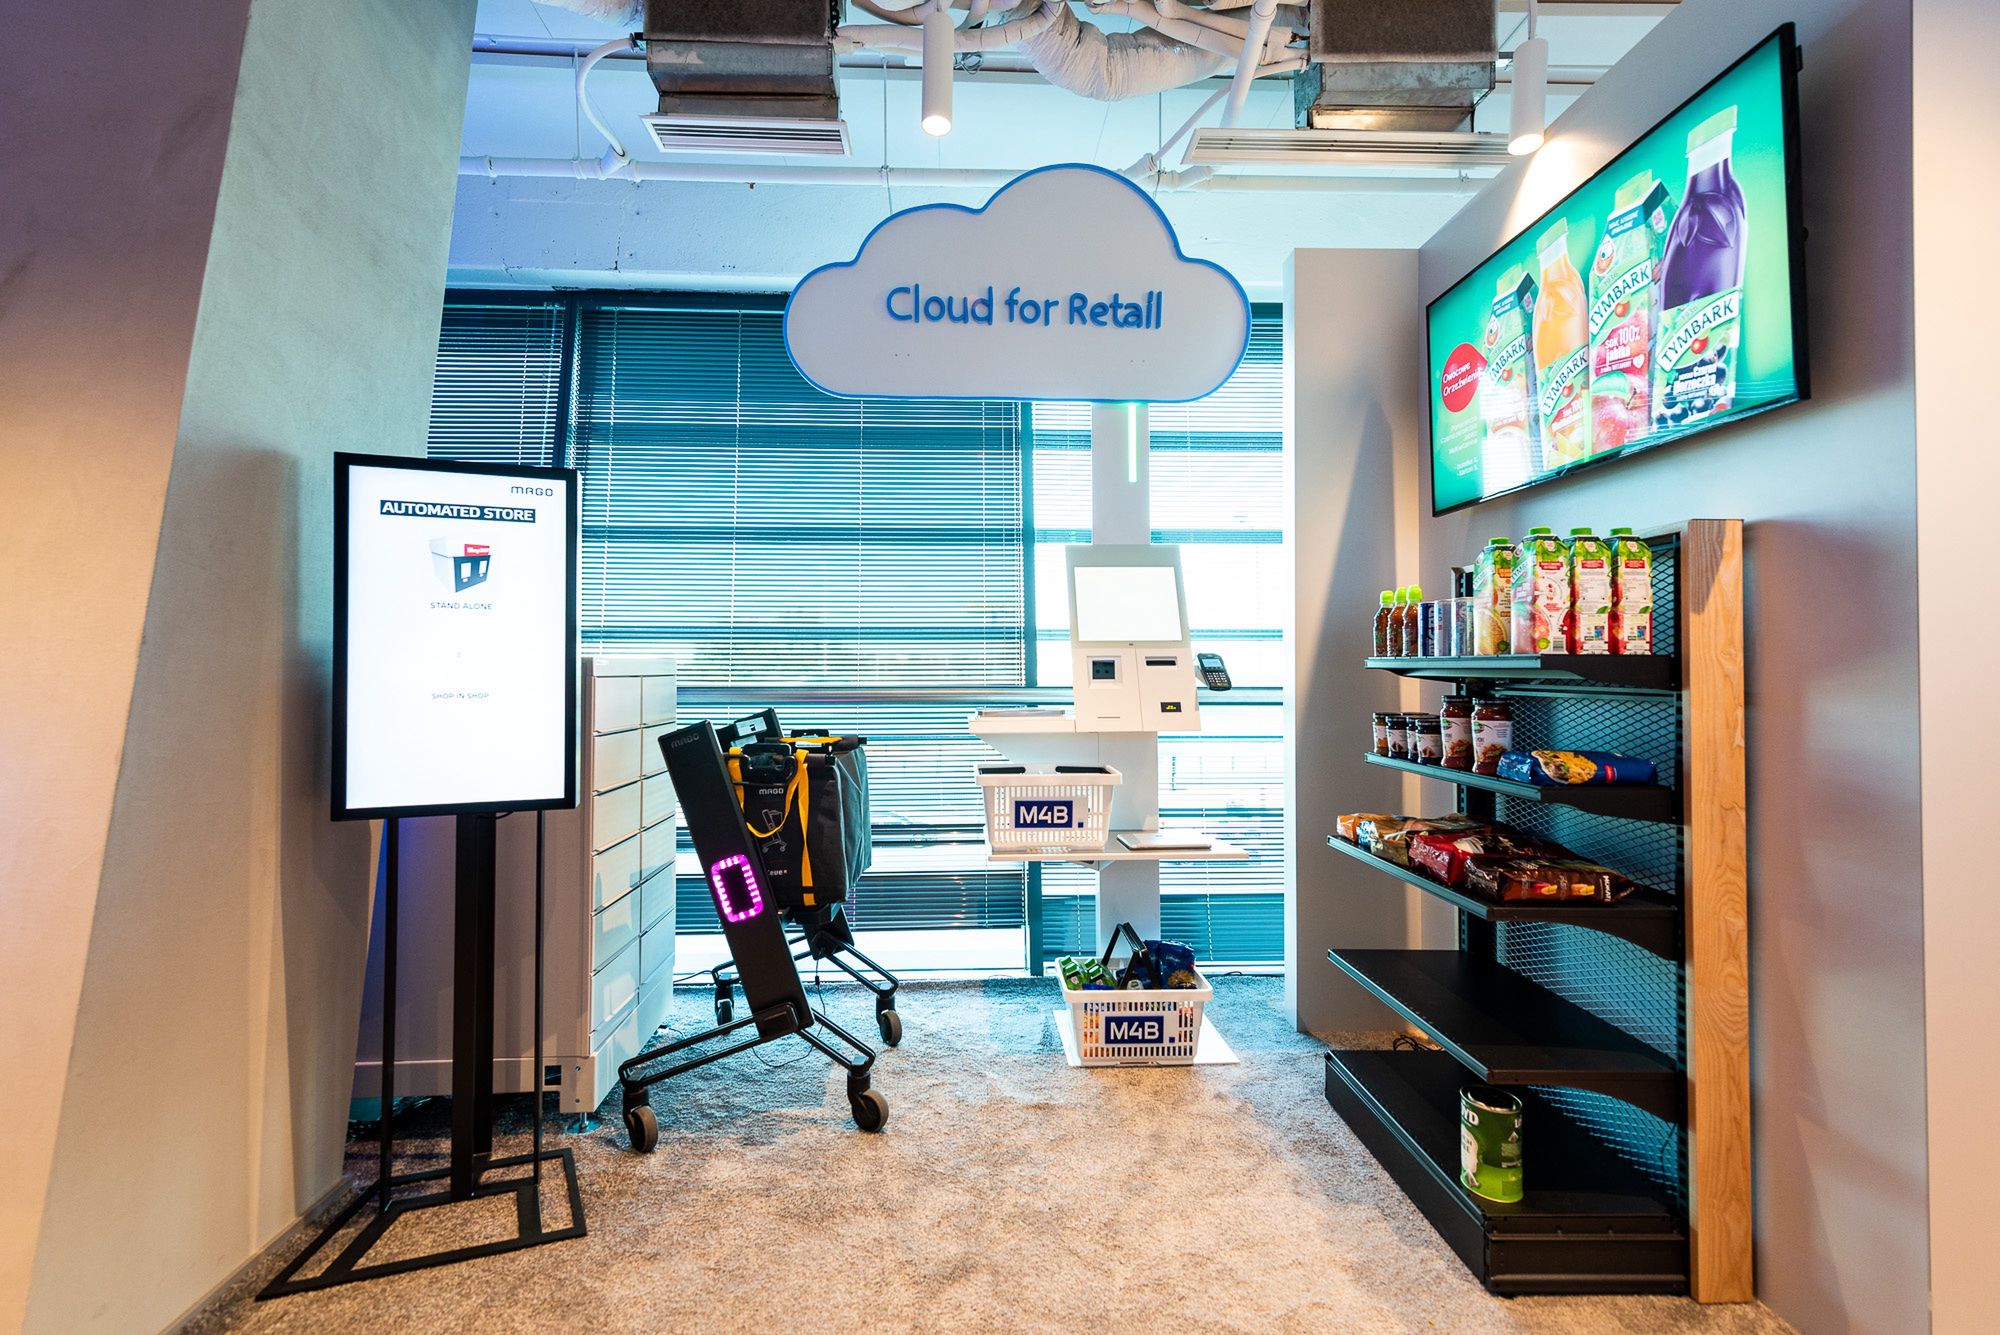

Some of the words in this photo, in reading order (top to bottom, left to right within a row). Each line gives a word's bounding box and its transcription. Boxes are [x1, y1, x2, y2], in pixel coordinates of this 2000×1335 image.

[886, 283, 994, 326] Cloud
[1004, 286, 1060, 327] for
[1068, 290, 1163, 330] Retail
[1590, 264, 1651, 327] TYMBARK
[1660, 297, 1734, 363] TYMBARK
[1543, 351, 1588, 409] TYMBARK
[381, 501, 481, 518] AUTOMATED
[483, 507, 534, 521] STORE
[511, 485, 554, 498] MAGO
[759, 787, 784, 795] MAGO
